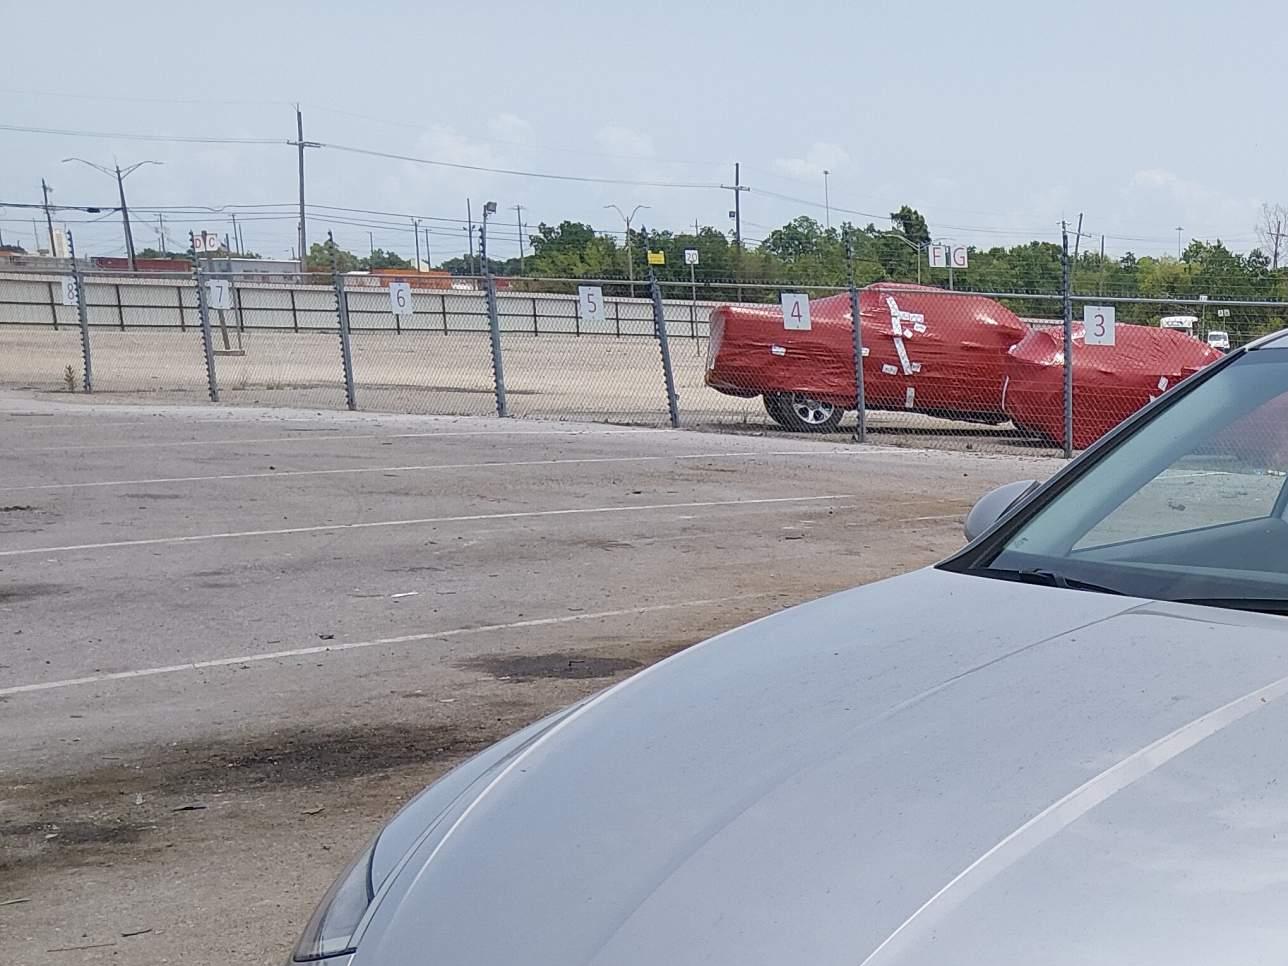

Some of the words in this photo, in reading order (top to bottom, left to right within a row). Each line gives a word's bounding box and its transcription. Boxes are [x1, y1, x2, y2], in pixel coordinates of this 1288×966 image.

[208, 237, 215, 248] C
[686, 252, 698, 264] 20
[932, 247, 941, 266] F
[953, 247, 965, 266] G
[67, 282, 77, 300] 8
[215, 285, 224, 303] 7
[396, 288, 405, 307] 6
[587, 293, 597, 313] 5
[790, 301, 803, 323] 4
[1093, 314, 1106, 337] 3
